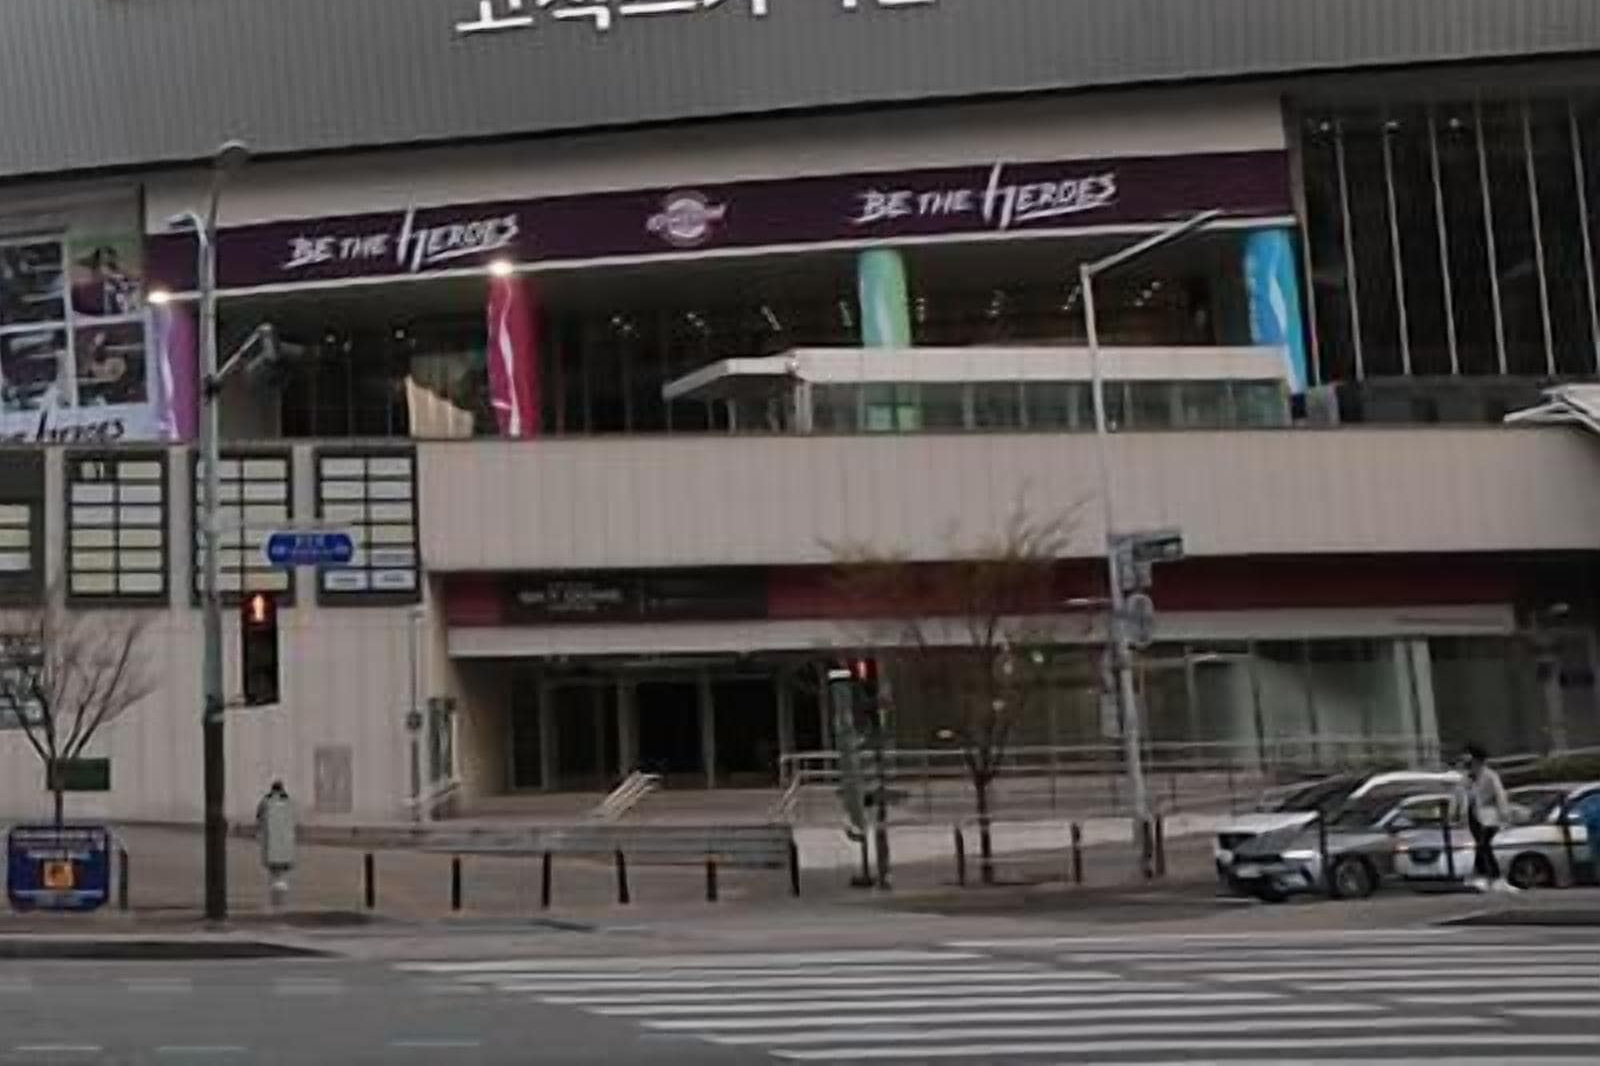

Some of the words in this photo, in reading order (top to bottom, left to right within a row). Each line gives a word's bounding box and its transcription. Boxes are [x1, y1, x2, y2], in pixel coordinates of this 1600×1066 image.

[854, 190, 913, 222] BE
[918, 189, 973, 215] THE
[983, 162, 1116, 229] HEROES
[282, 236, 335, 269] BE
[396, 200, 519, 273] HEROES
